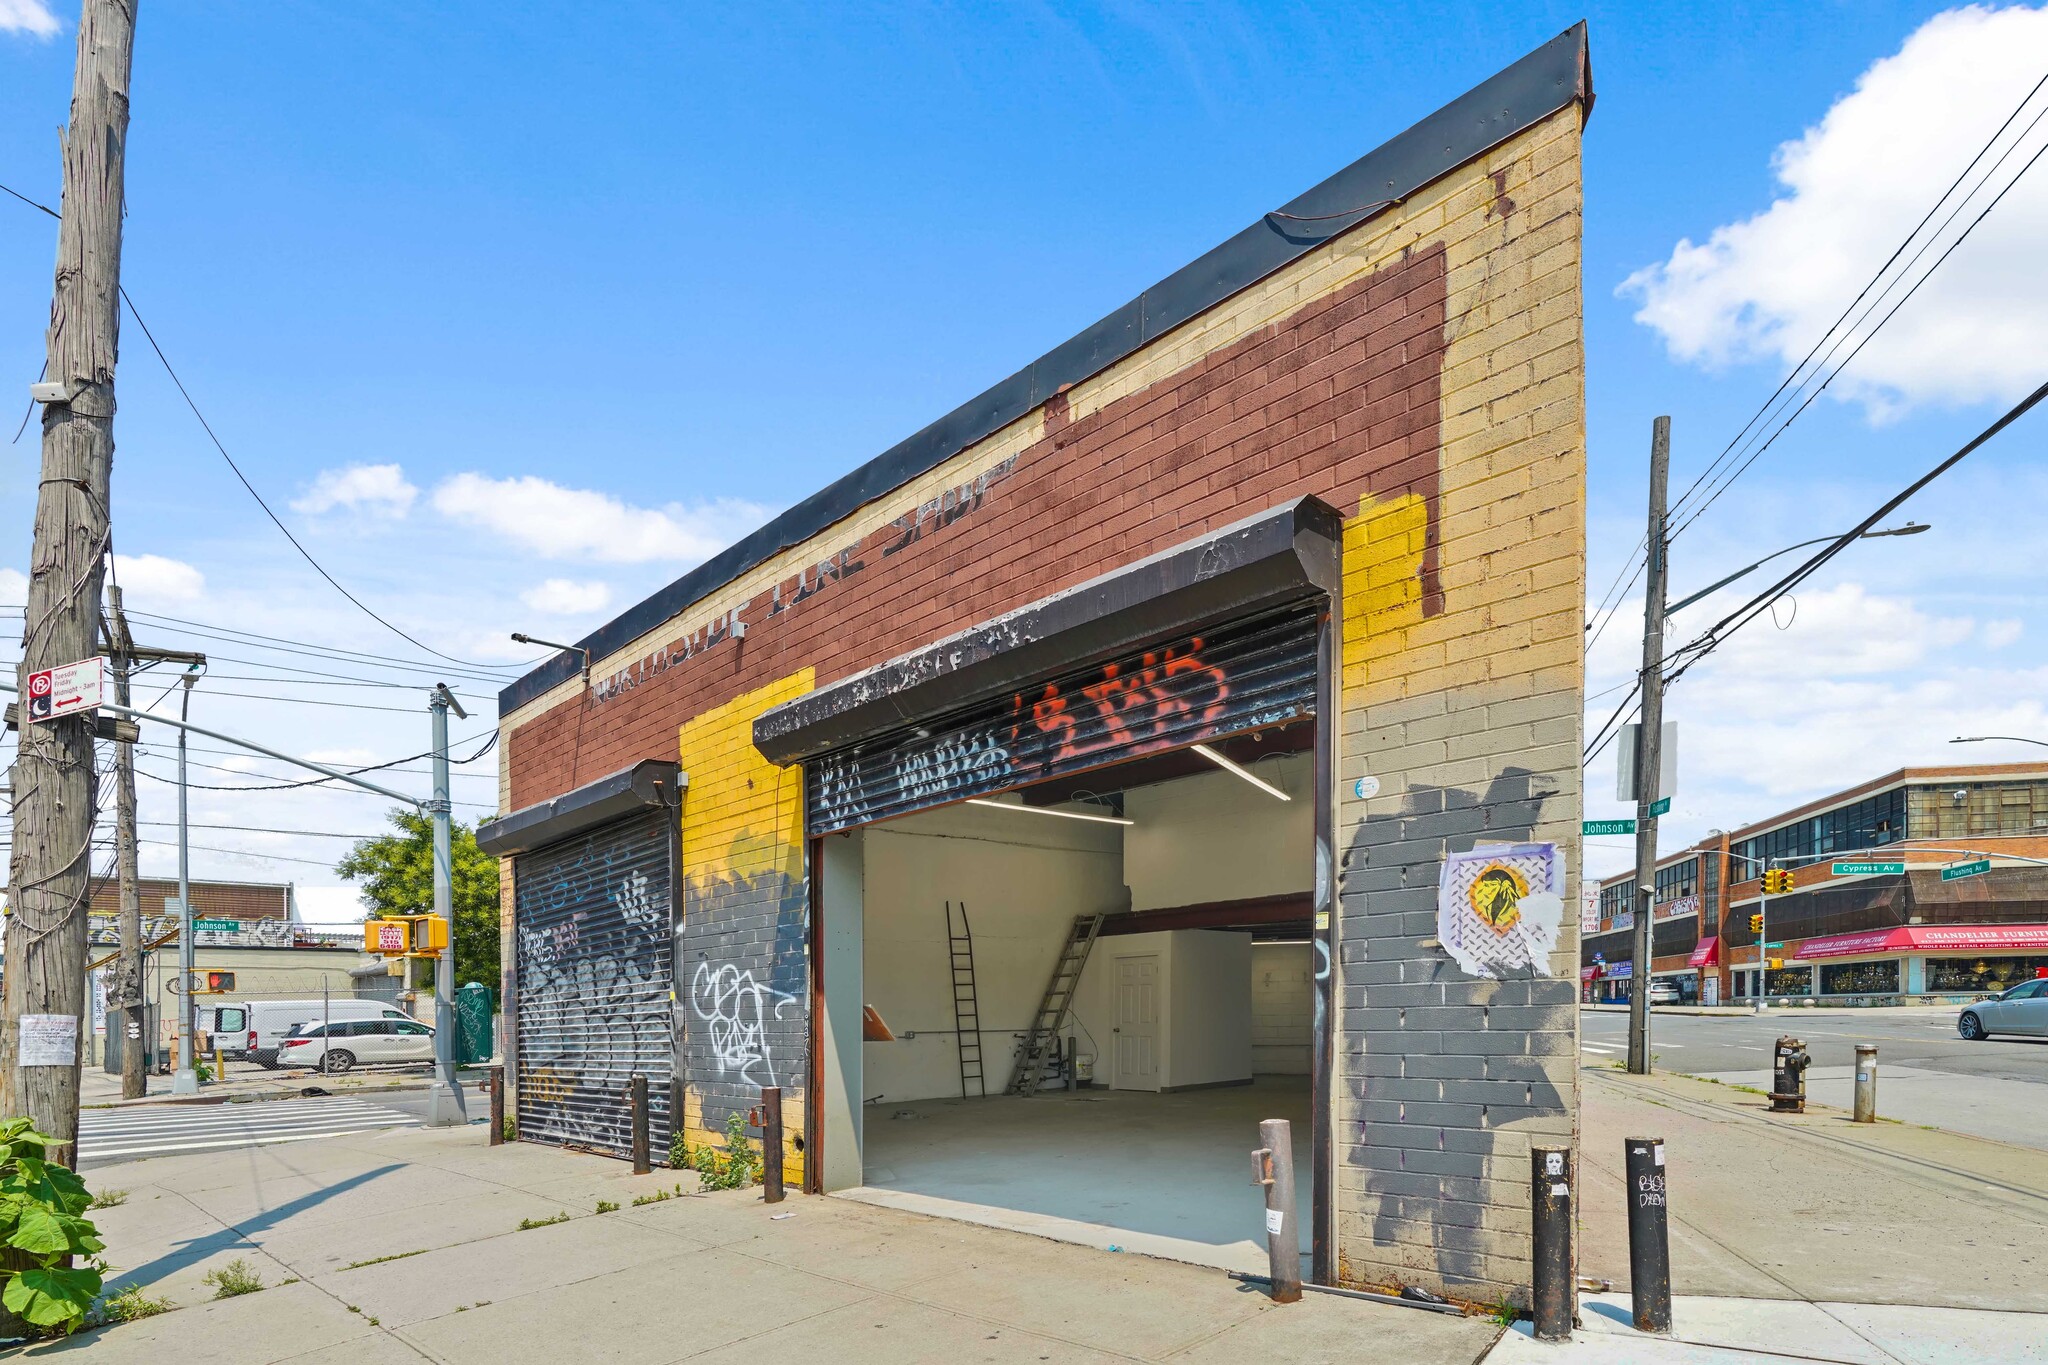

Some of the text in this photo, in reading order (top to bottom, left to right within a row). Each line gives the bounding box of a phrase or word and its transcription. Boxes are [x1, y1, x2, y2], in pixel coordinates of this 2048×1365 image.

[54, 670, 77, 679] Tuesday
[54, 679, 72, 687] Friday
[54, 686, 78, 696] Midnight
[83, 682, 96, 690] 3am
[1584, 821, 1635, 834] Johnson Av
[1843, 864, 1878, 873] Cypress
[1950, 864, 1983, 878] Flushing Av
[1589, 900, 1595, 908] 7
[195, 921, 227, 930] Johnson
[1584, 923, 1599, 931] 1706
[1926, 931, 1999, 940] CHANDELIER
